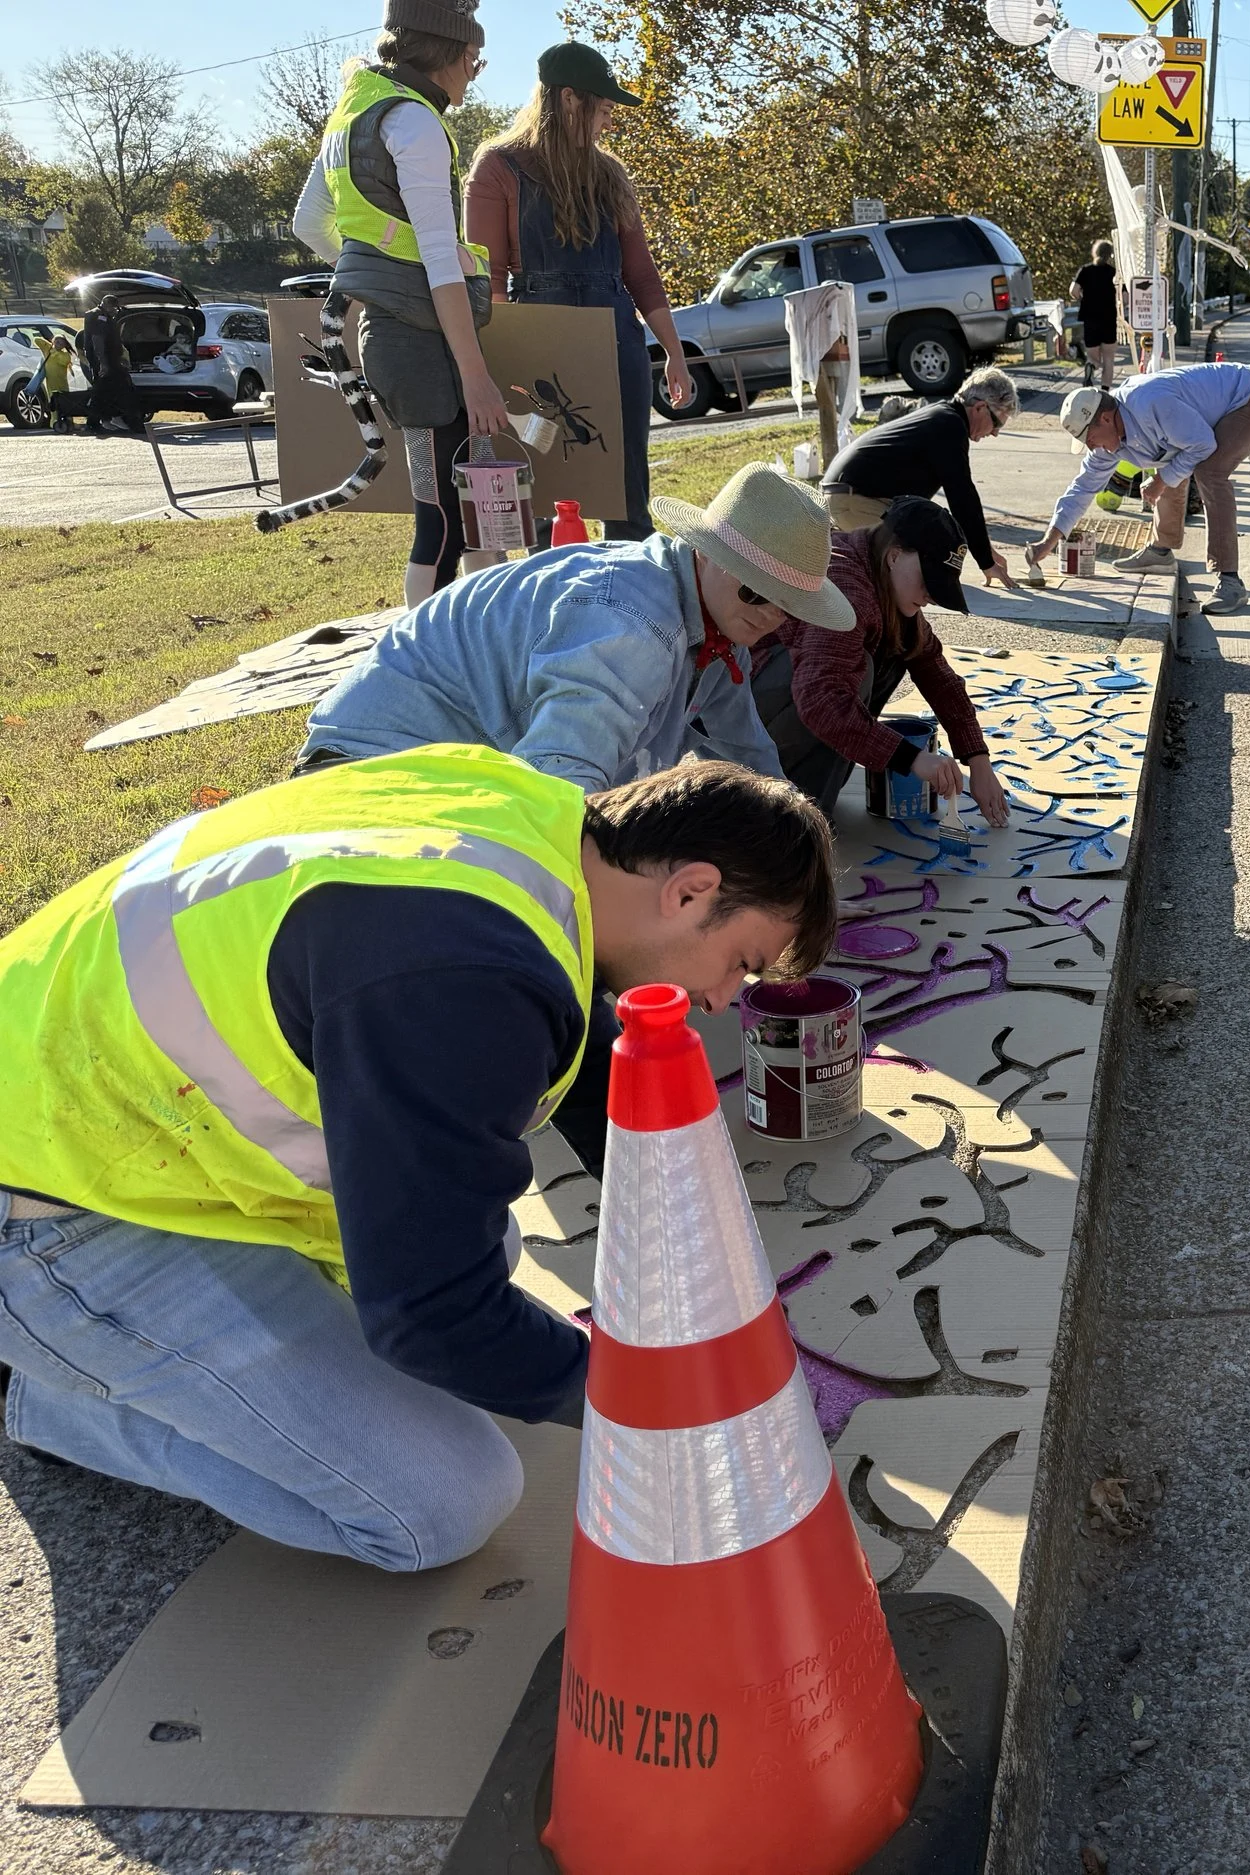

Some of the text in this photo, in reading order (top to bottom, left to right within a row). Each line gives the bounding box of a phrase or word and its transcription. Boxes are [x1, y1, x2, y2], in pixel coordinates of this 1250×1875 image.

[1113, 97, 1145, 119] LAW
[816, 1058, 853, 1080] COLORTOP
[565, 1655, 719, 1770] VISION ZERO
[786, 1694, 848, 1747] Made
